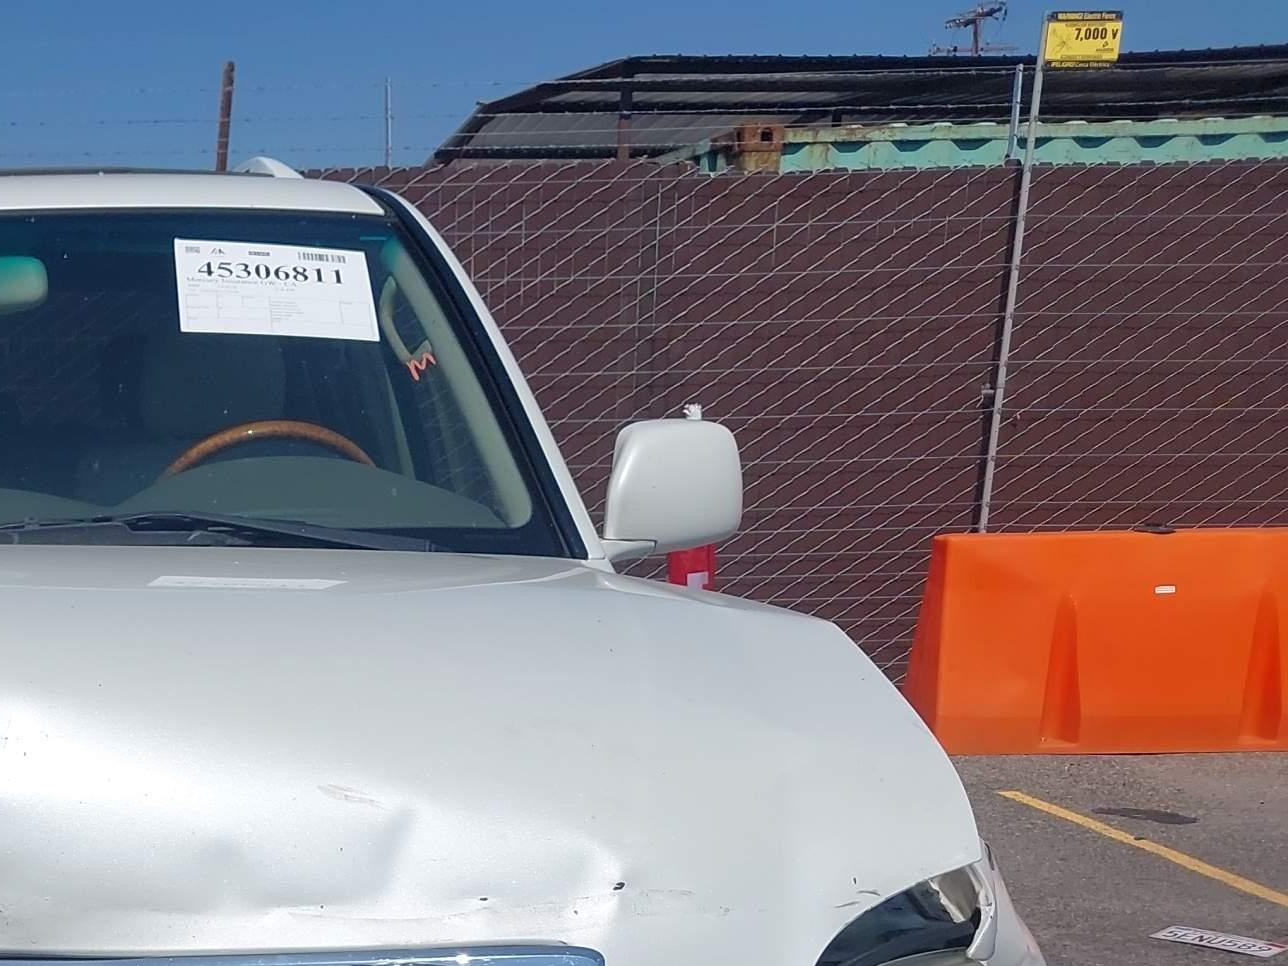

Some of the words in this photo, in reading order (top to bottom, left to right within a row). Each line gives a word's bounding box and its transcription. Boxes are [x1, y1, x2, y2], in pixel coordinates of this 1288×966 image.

[1074, 27, 1108, 42] 7,000
[1111, 27, 1119, 40] V
[197, 261, 343, 285] 45306811
